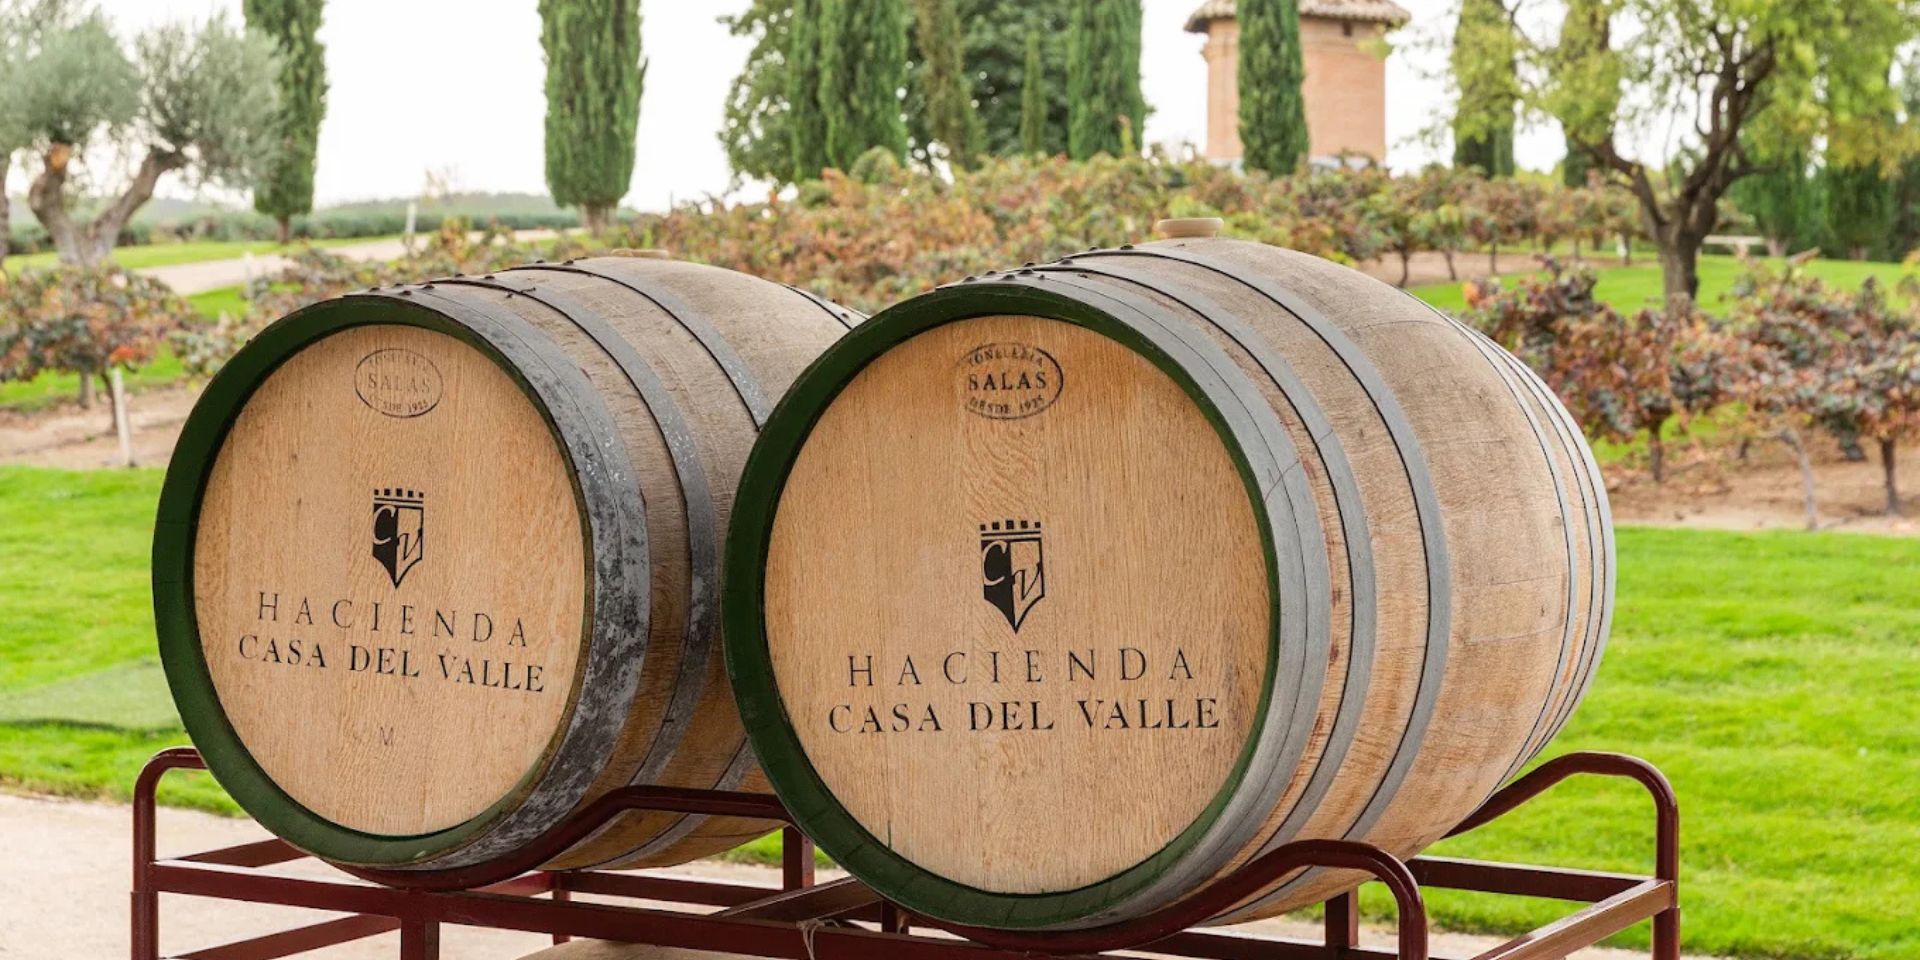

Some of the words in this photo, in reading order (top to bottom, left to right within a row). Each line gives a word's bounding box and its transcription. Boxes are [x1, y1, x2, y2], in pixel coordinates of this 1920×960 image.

[368, 373, 430, 393] SALAS
[969, 371, 1047, 391] SALAS
[258, 591, 527, 647] HACIENDA
[239, 634, 327, 668] CASA
[349, 645, 419, 678] DEL
[437, 653, 544, 692] VALLE
[848, 647, 1193, 687] HACIENDA
[828, 703, 943, 733] CASA
[967, 701, 1054, 730] DEL
[1076, 698, 1219, 729] VALLE
